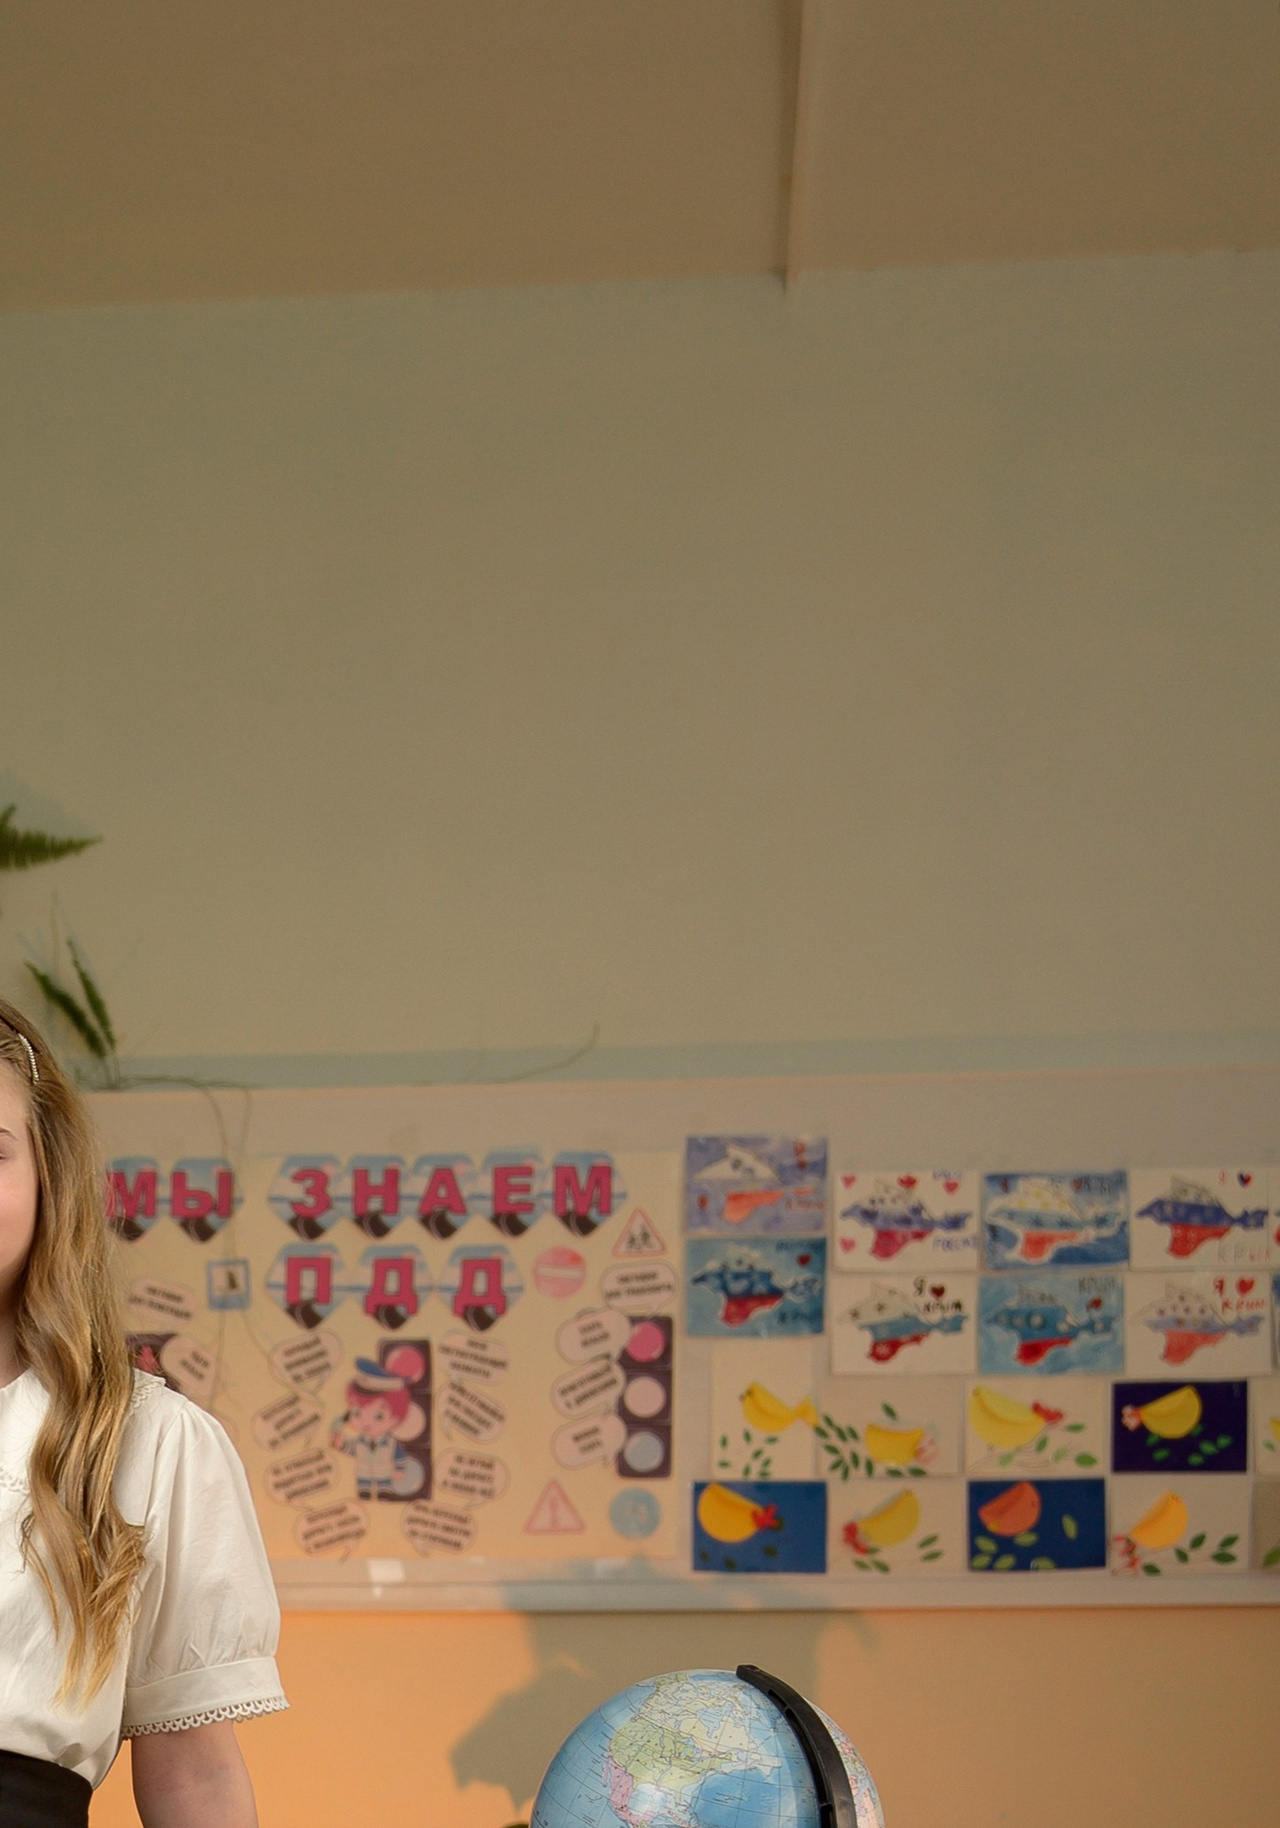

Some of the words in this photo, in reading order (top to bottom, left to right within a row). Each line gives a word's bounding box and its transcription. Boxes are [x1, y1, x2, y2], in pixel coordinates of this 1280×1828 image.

[106, 1170, 233, 1218] МЫ
[290, 1166, 612, 1217] ЗНАЕМ
[286, 1256, 508, 1316] ПДД
